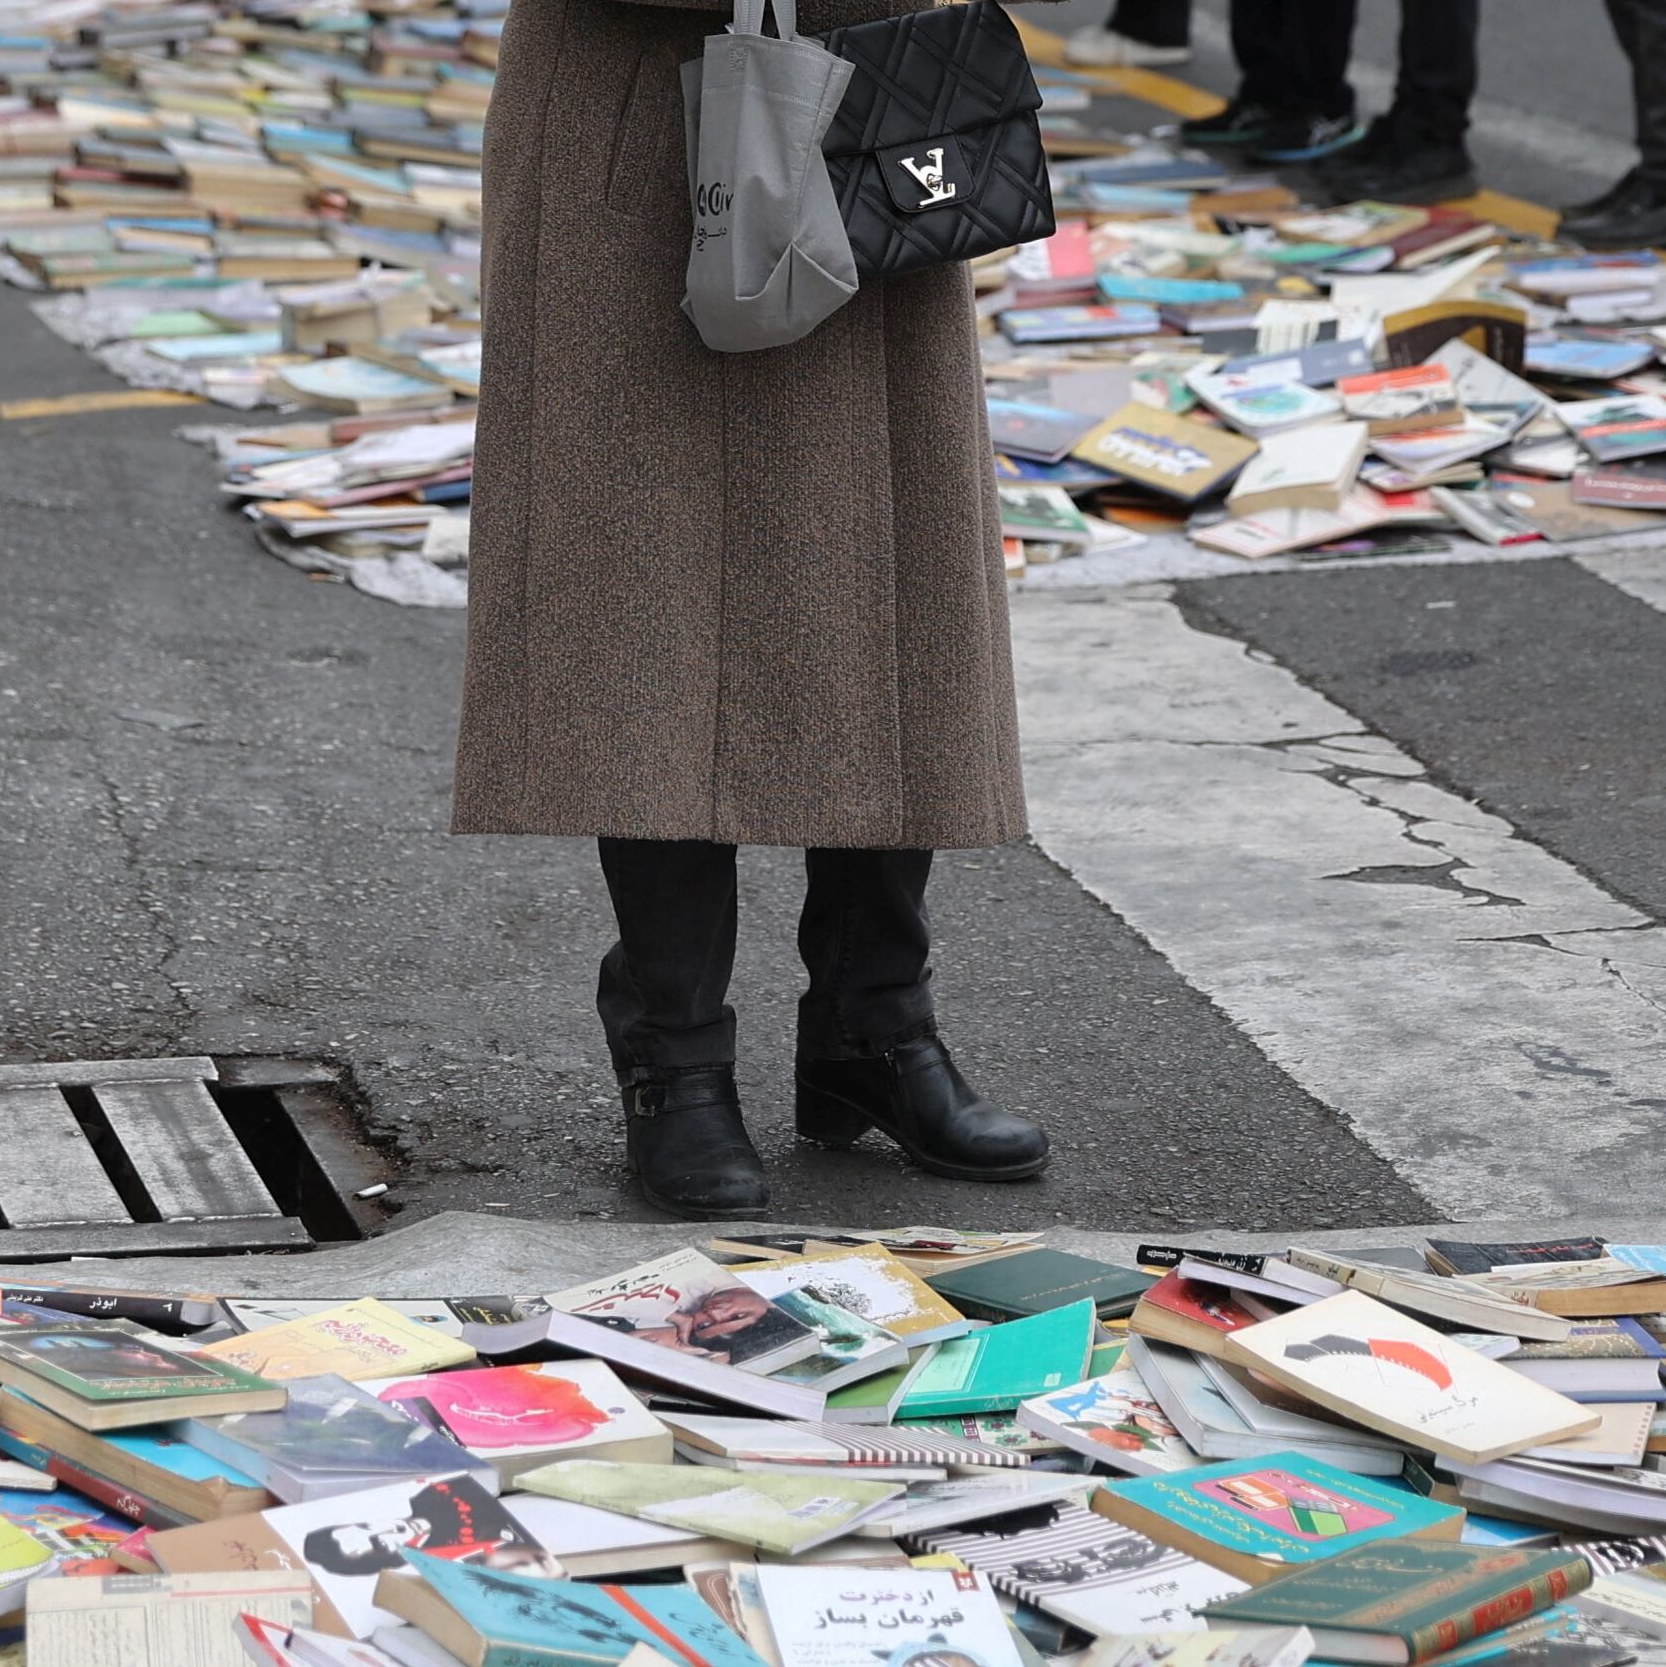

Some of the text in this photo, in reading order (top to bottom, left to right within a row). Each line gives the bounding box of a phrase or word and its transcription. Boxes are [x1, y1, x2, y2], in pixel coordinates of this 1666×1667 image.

[88, 1295, 118, 1310] ابوذر
[838, 1588, 935, 1607] از دخترت
[813, 1602, 965, 1632] قهرمان بساز
